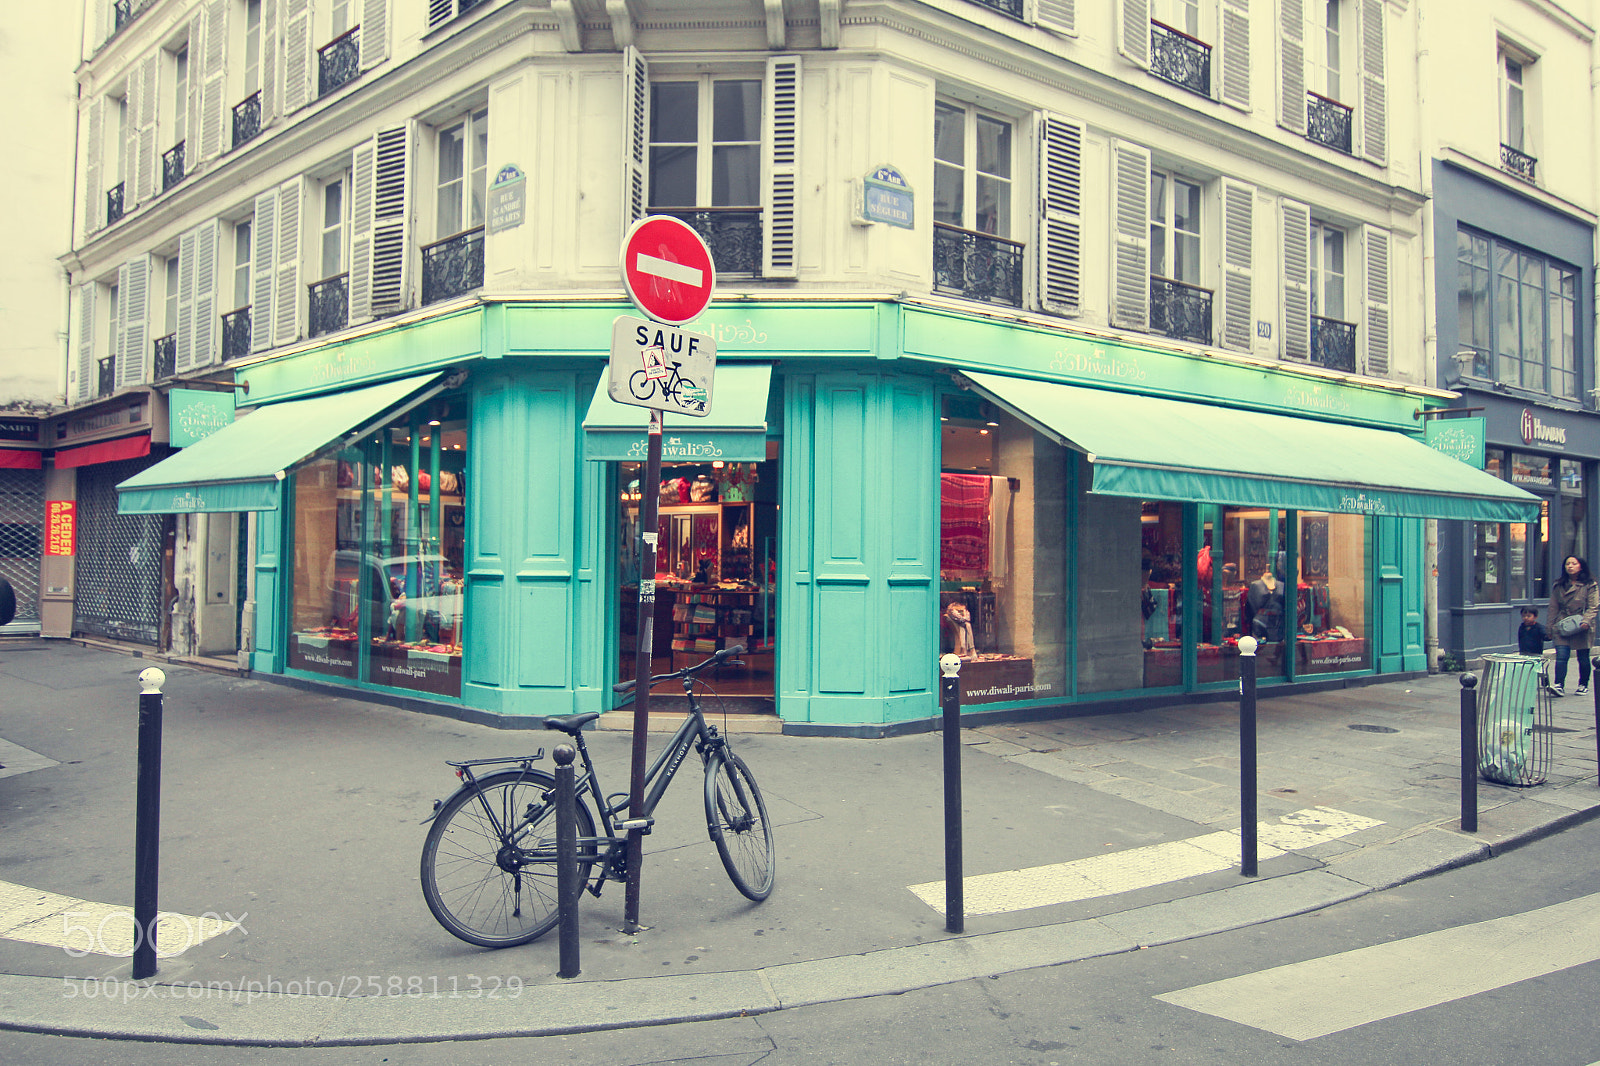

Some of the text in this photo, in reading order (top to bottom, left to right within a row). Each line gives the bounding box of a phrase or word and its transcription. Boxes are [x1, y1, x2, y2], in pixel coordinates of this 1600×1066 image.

[880, 194, 899, 206] RUE
[1259, 322, 1270, 337] 20
[636, 325, 699, 356] SAUF
[661, 443, 699, 456] iwali
[60, 501, 73, 555] A CEDER
[1311, 655, 1362, 665] www.diwali-paris.com
[966, 682, 1052, 697] www.diwali-paris.com
